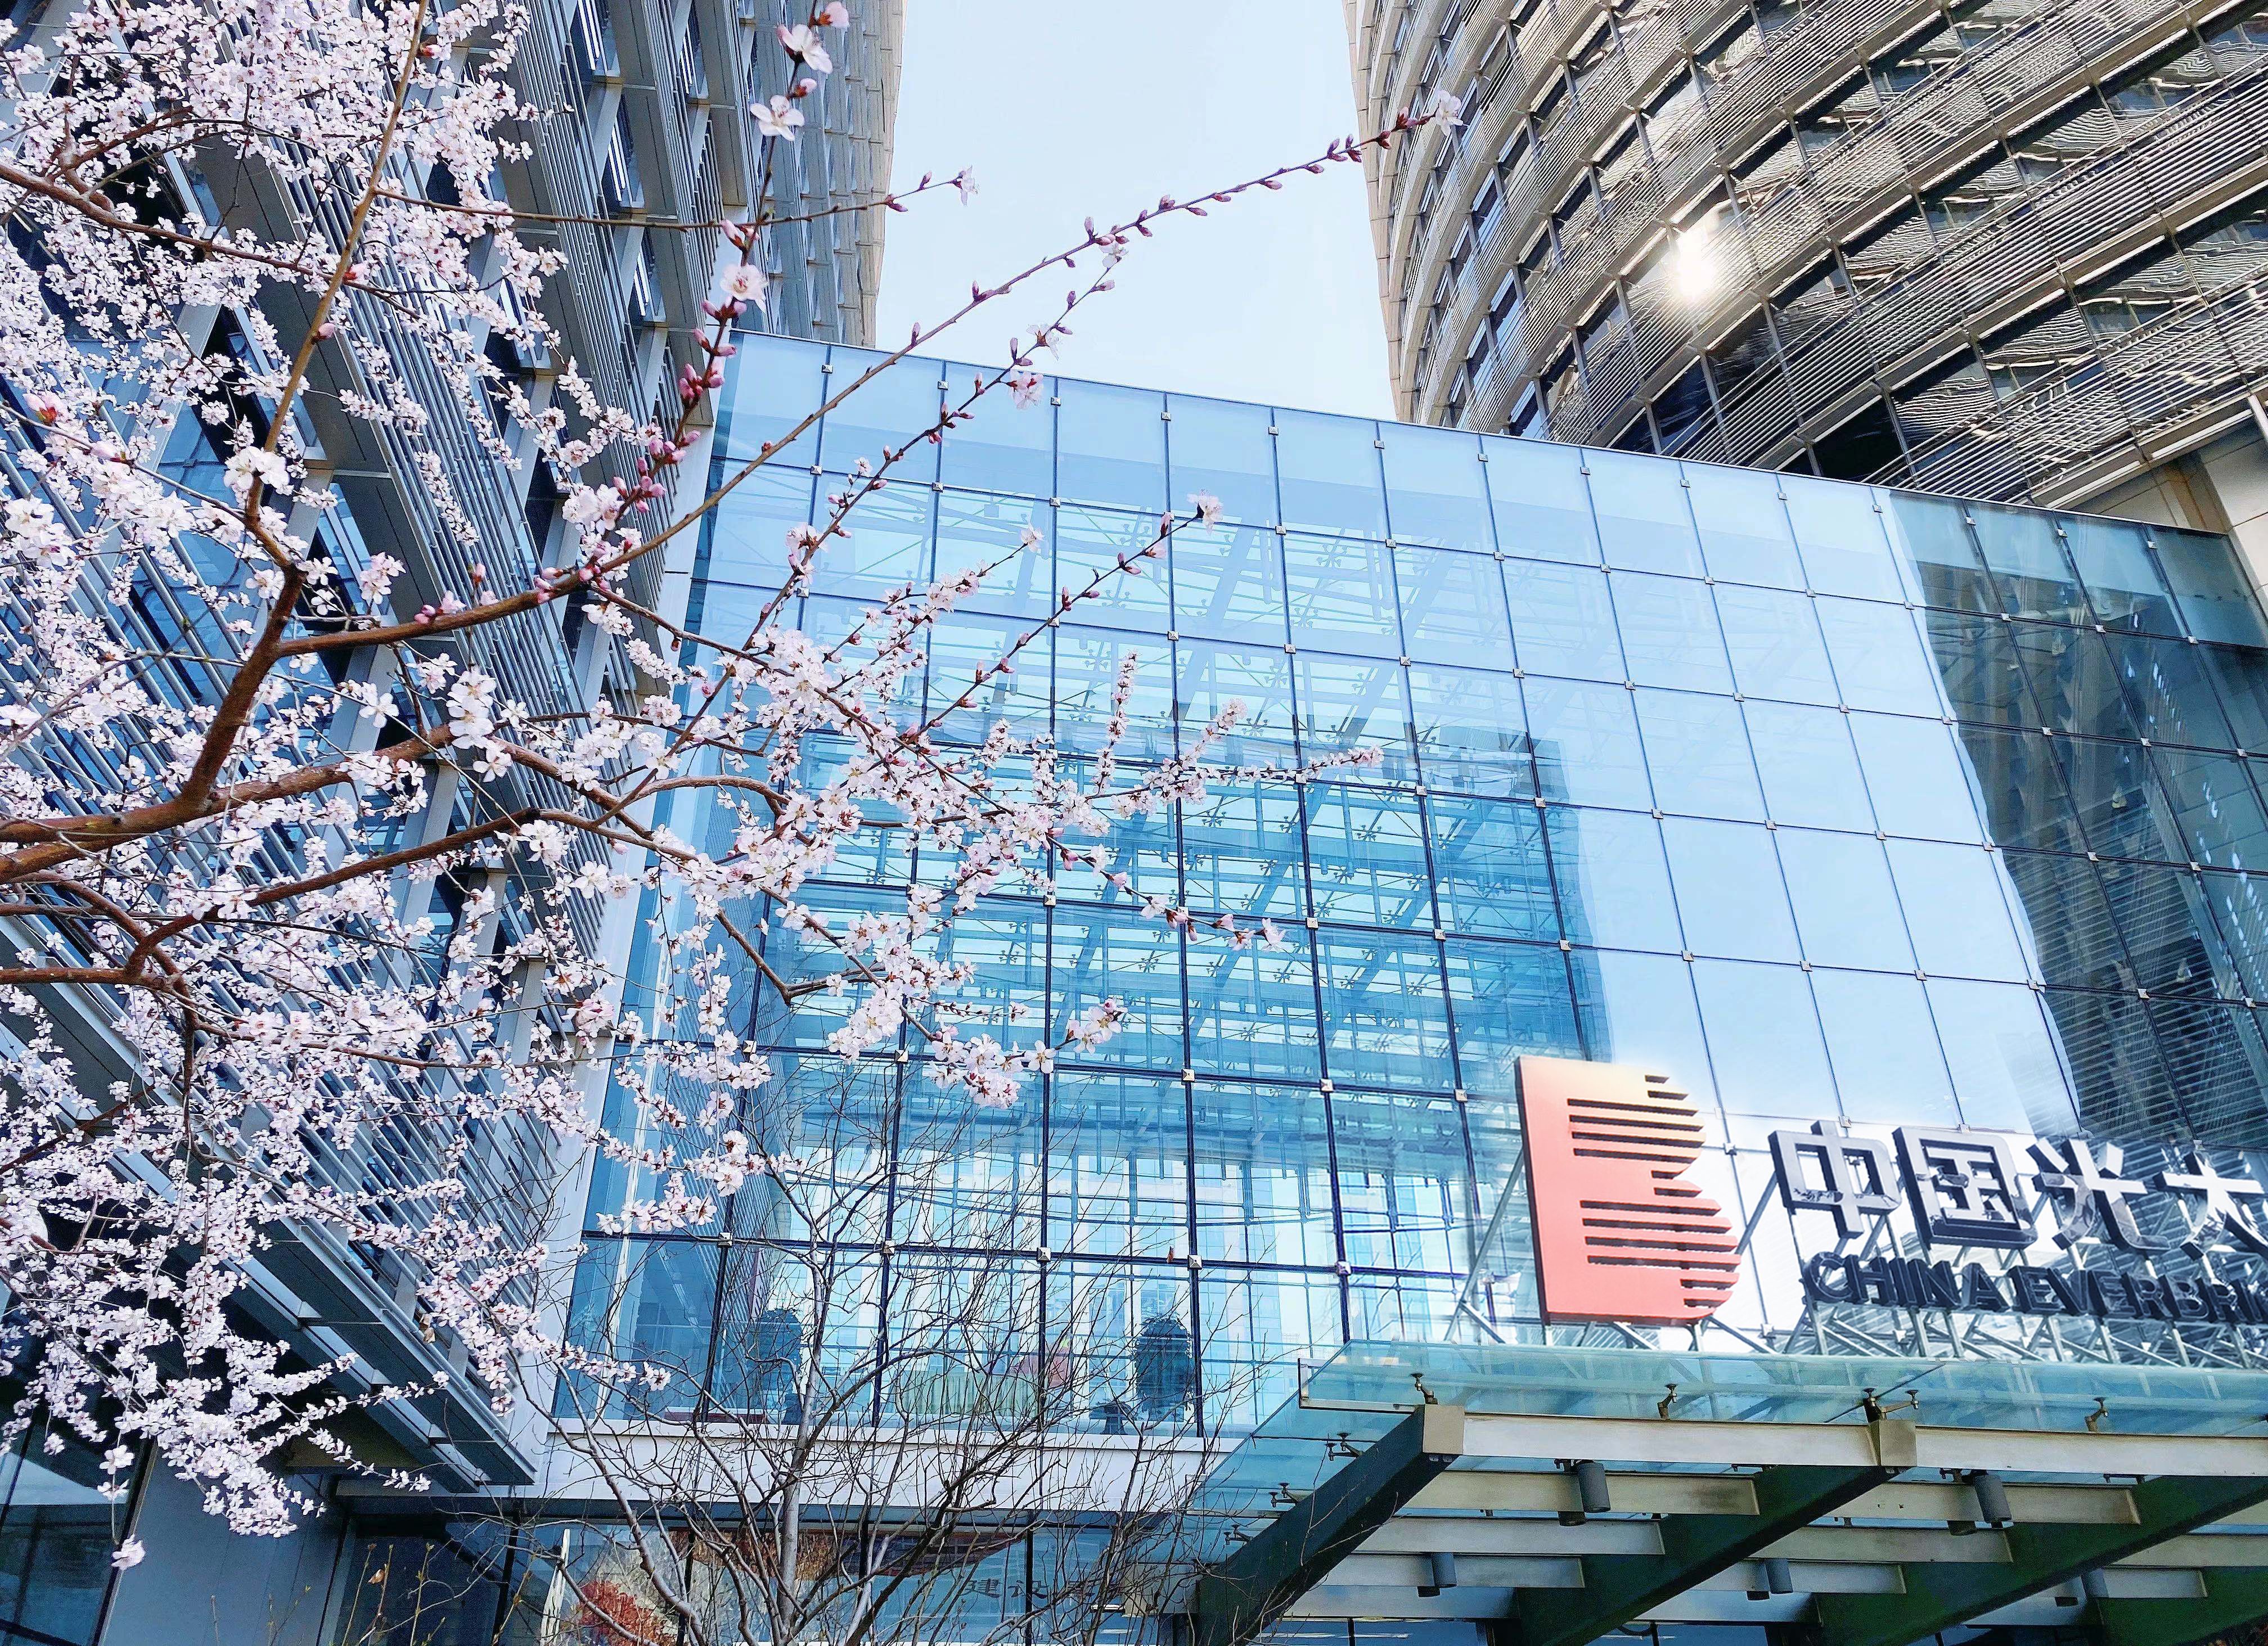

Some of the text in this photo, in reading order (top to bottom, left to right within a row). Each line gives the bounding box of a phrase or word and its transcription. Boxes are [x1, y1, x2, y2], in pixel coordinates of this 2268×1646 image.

[1768, 1120, 2268, 1261] 中国光大
[1802, 1251, 2268, 1323] CHINA EVERBRI
